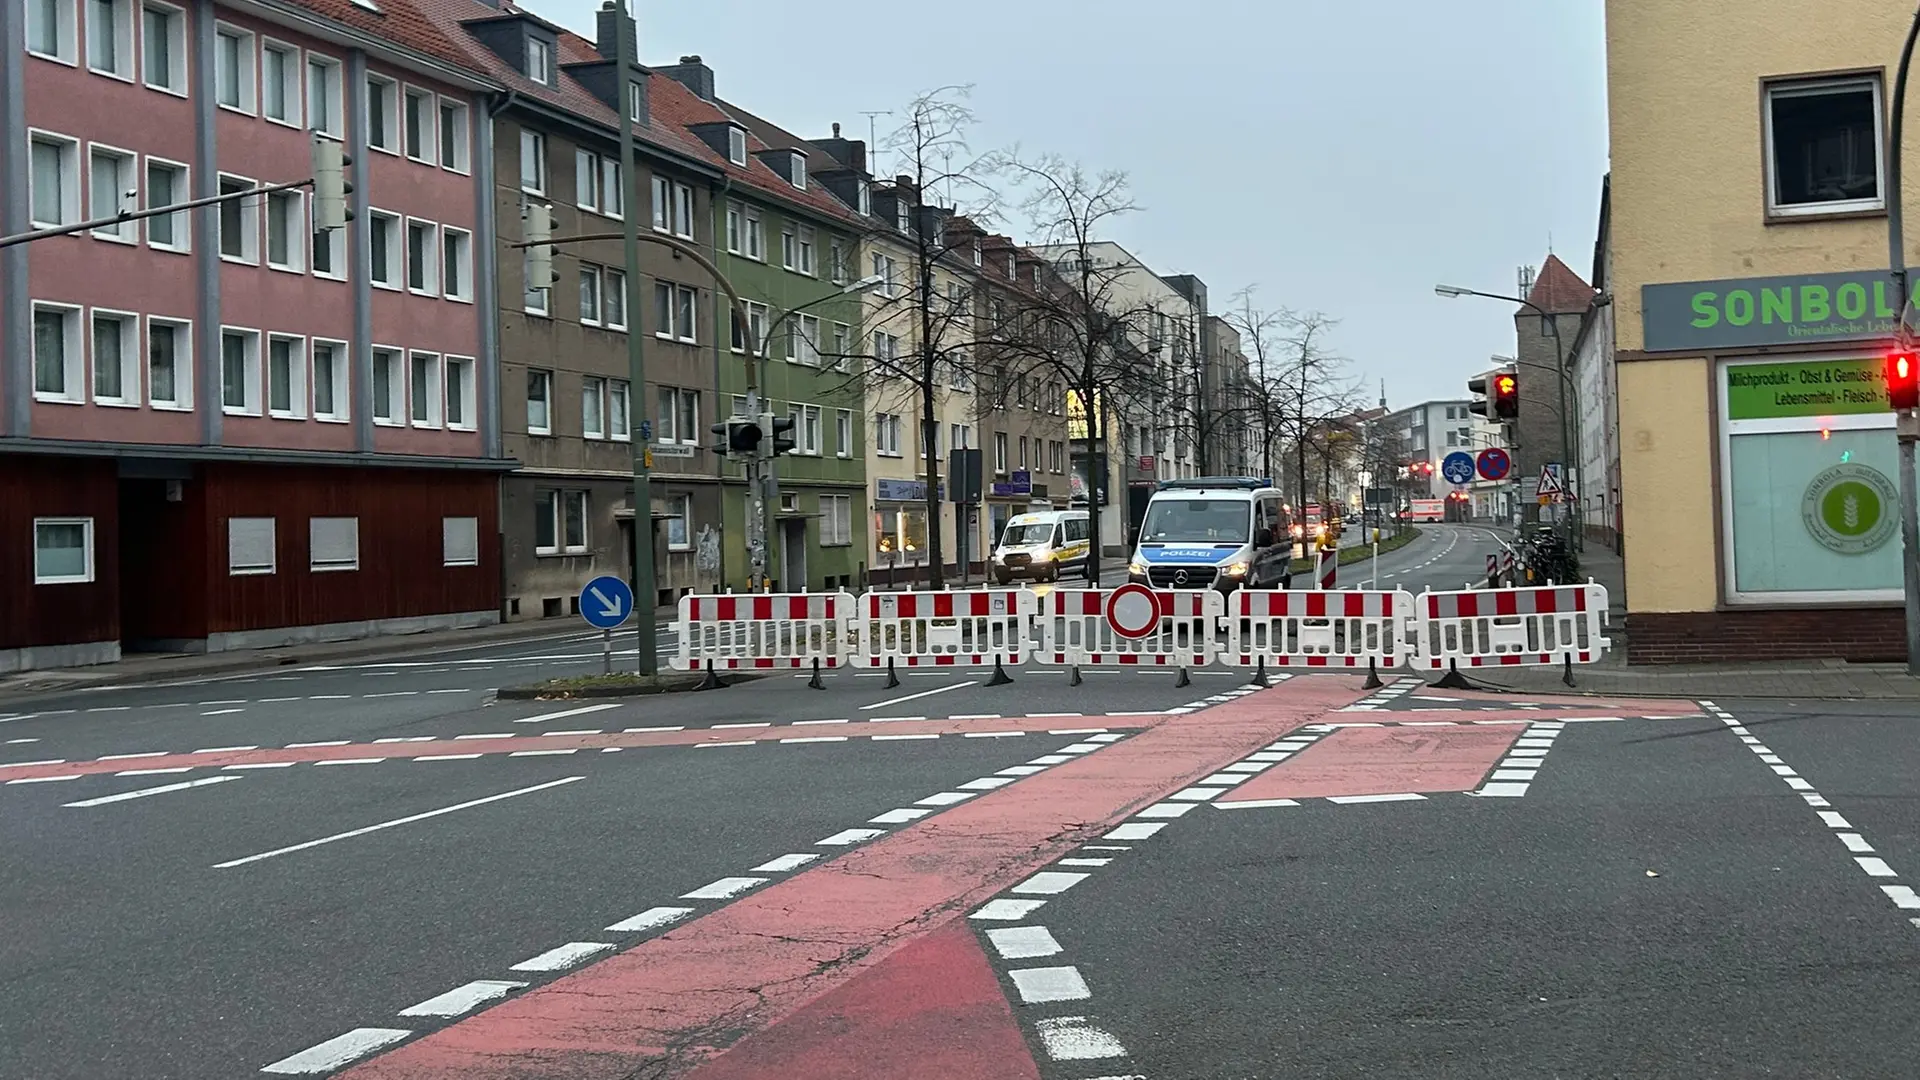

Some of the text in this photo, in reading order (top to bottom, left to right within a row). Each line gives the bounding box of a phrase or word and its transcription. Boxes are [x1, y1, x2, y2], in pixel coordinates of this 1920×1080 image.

[1787, 321, 1864, 337] Orientalische
[1728, 371, 1790, 389] Milchprodukt
[1800, 369, 1822, 384] Obst
[1825, 368, 1832, 383] &
[1834, 367, 1873, 383] Gemüse
[1775, 389, 1835, 405] Lebensmittel
[1843, 388, 1877, 403] Fleisch
[1160, 550, 1211, 558] POLIZEI
